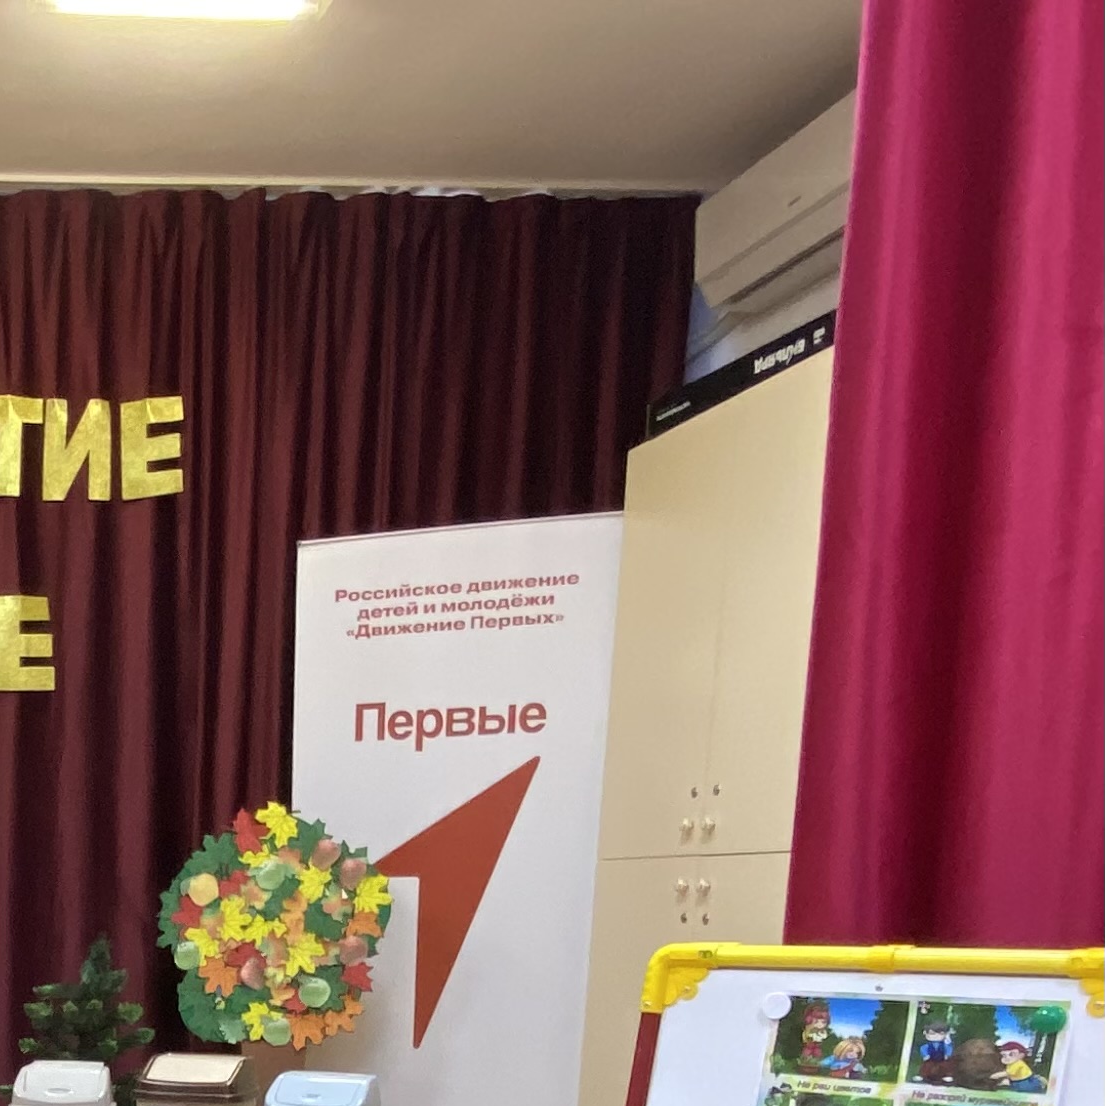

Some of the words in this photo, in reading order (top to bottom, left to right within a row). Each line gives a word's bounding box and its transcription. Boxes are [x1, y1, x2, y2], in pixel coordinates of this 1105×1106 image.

[334, 581, 463, 602] Российское
[466, 572, 581, 595] движение
[357, 600, 419, 622] детей
[423, 601, 436, 614] и
[441, 593, 556, 613] молодёжи
[346, 619, 467, 640] «Движение
[470, 613, 565, 631] Первых»
[354, 701, 548, 752] Первые
